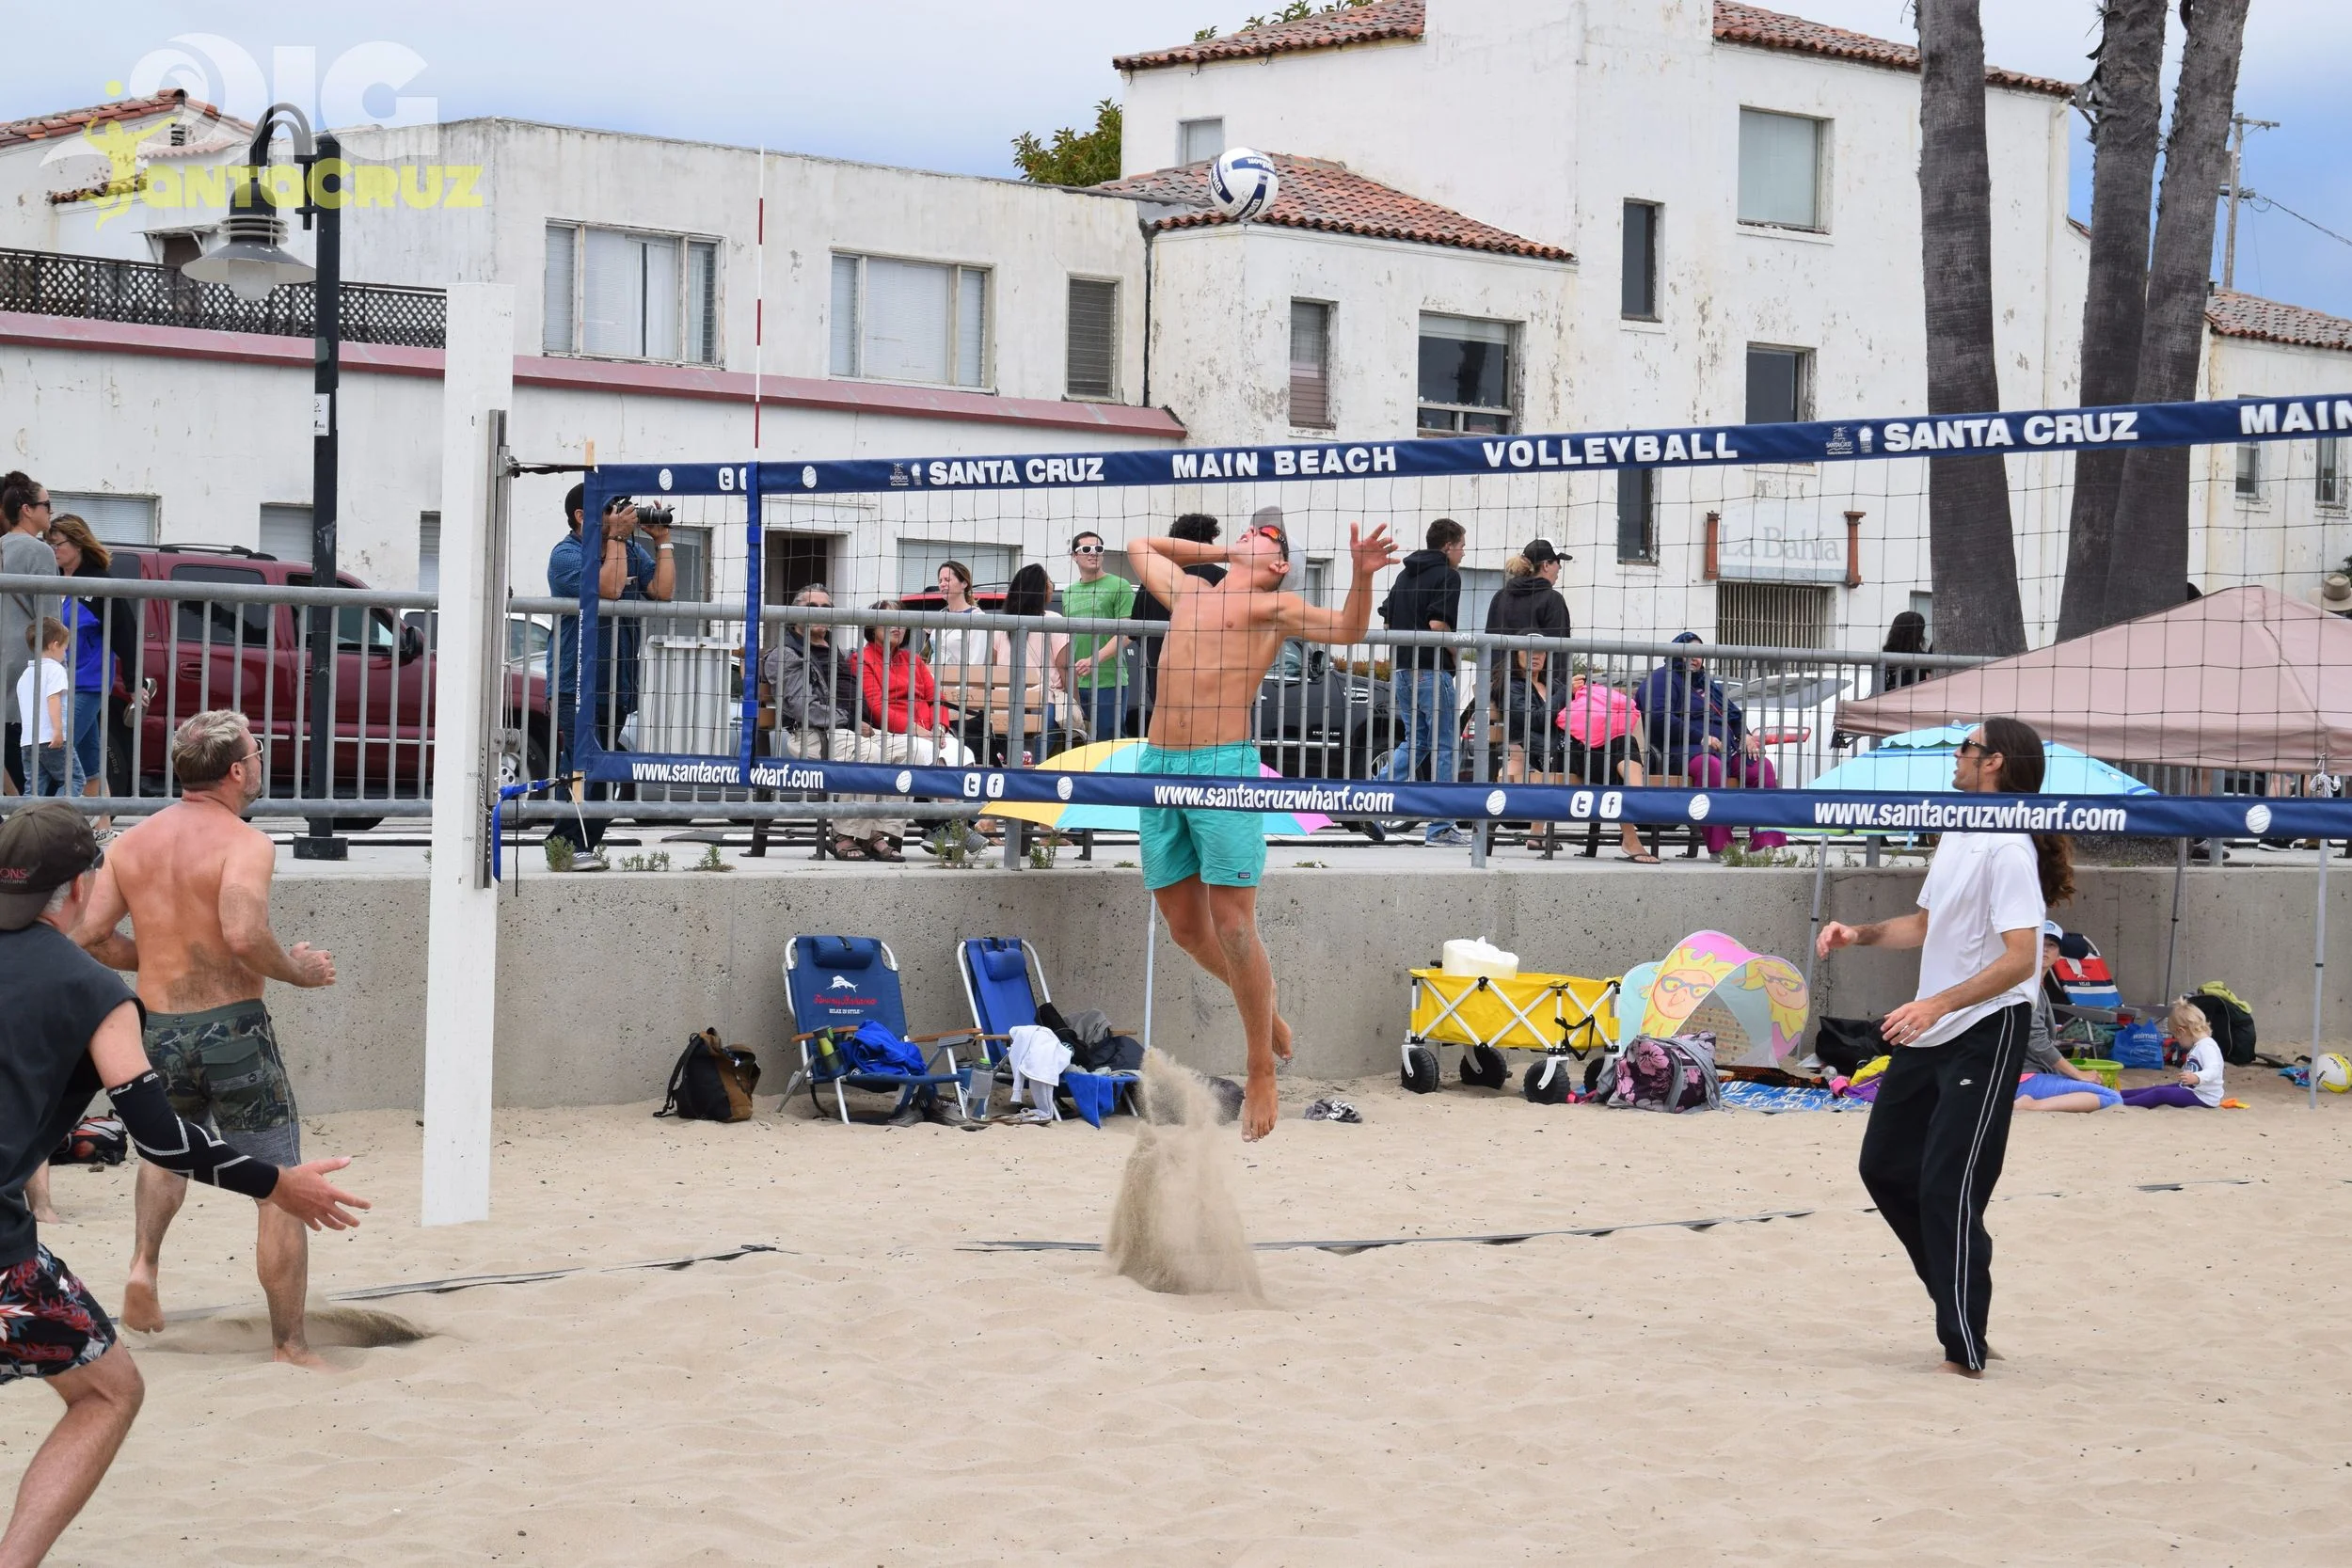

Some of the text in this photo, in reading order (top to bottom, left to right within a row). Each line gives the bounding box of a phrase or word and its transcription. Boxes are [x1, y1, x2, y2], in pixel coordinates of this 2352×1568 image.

[1883, 412, 2138, 451] SANTA CRUZ
[1172, 447, 1397, 479] MAIN BEACH
[1482, 433, 1739, 467] VOLLEYBALL
[929, 457, 1104, 486] SANTA CRUZ
[1721, 524, 1757, 558] La
[1154, 784, 1394, 813] www.santacruzwharf.com
[1815, 800, 2126, 832] www.santacruzwharf.com
